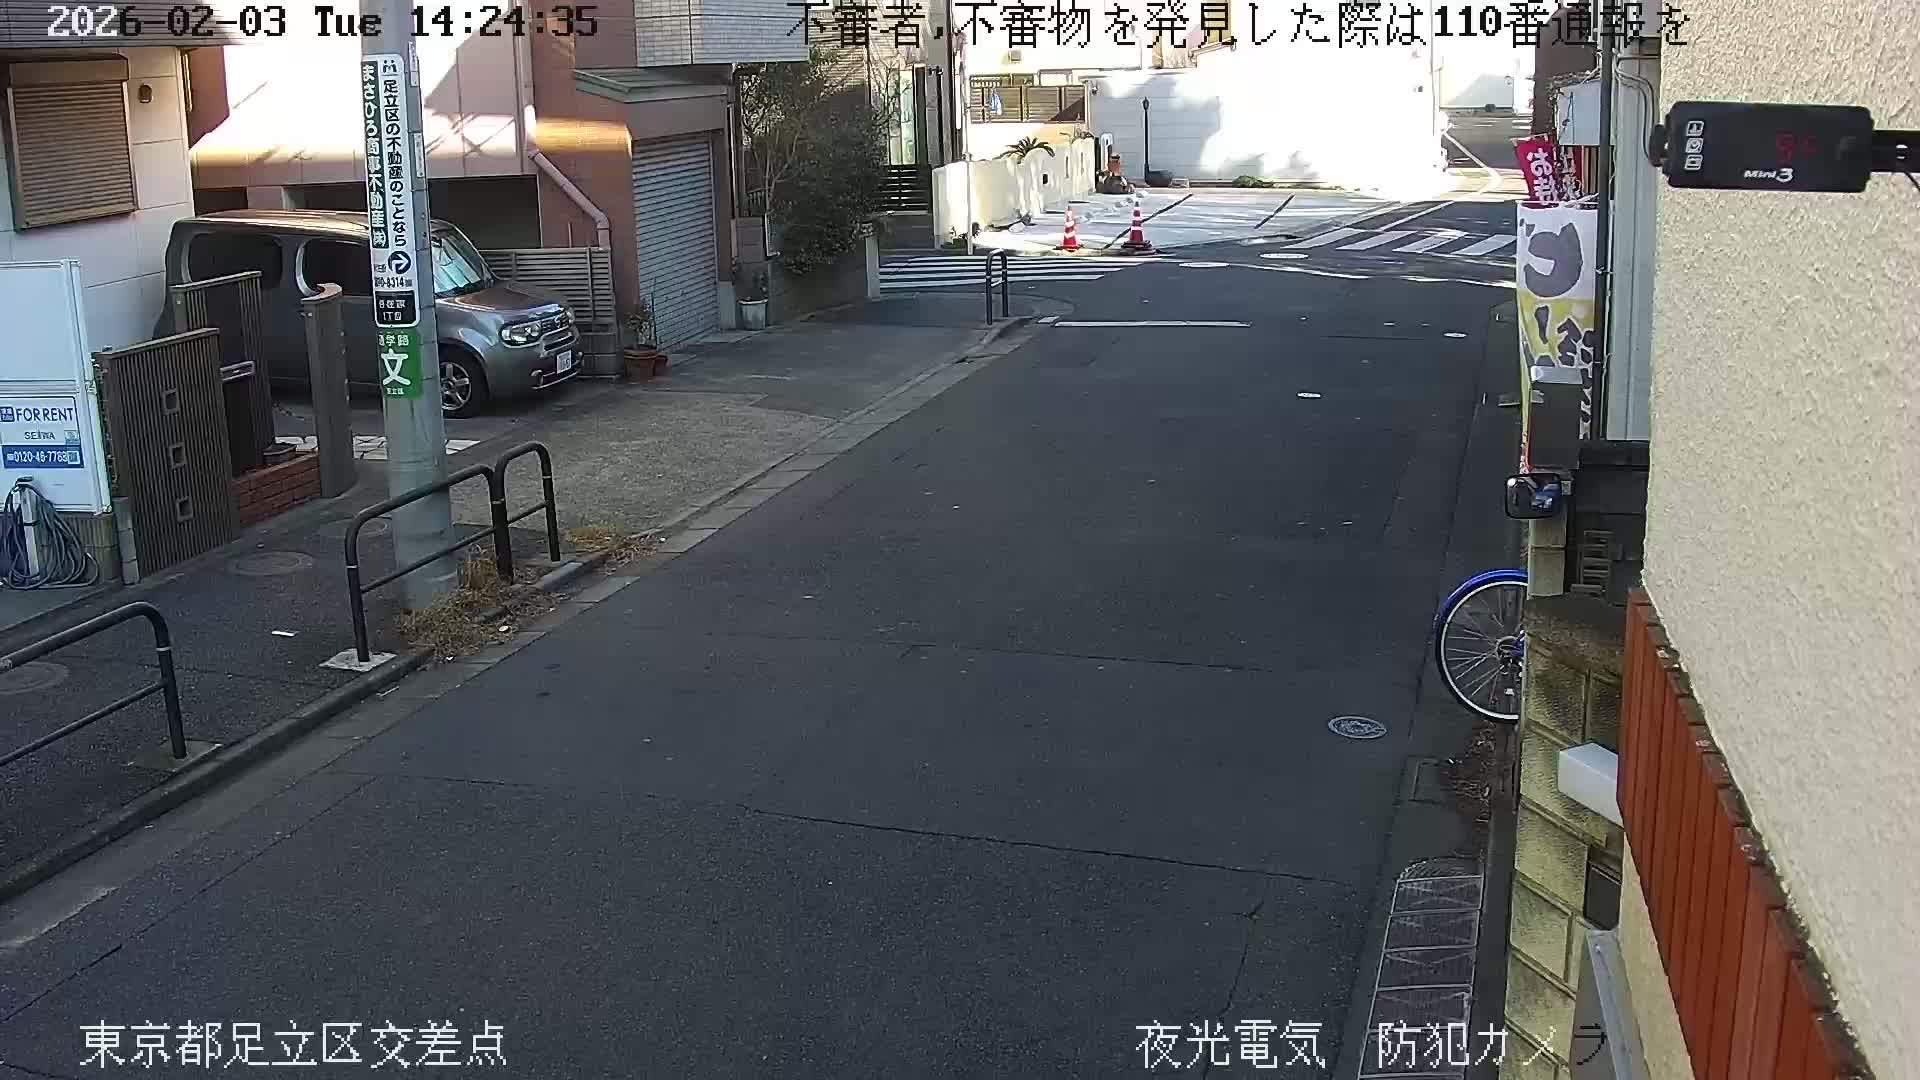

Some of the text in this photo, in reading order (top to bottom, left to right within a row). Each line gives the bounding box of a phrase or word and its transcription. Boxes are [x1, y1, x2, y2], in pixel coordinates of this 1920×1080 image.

[380, 348, 411, 386] 文
[16, 407, 40, 422] FOR
[42, 407, 73, 422] RENT
